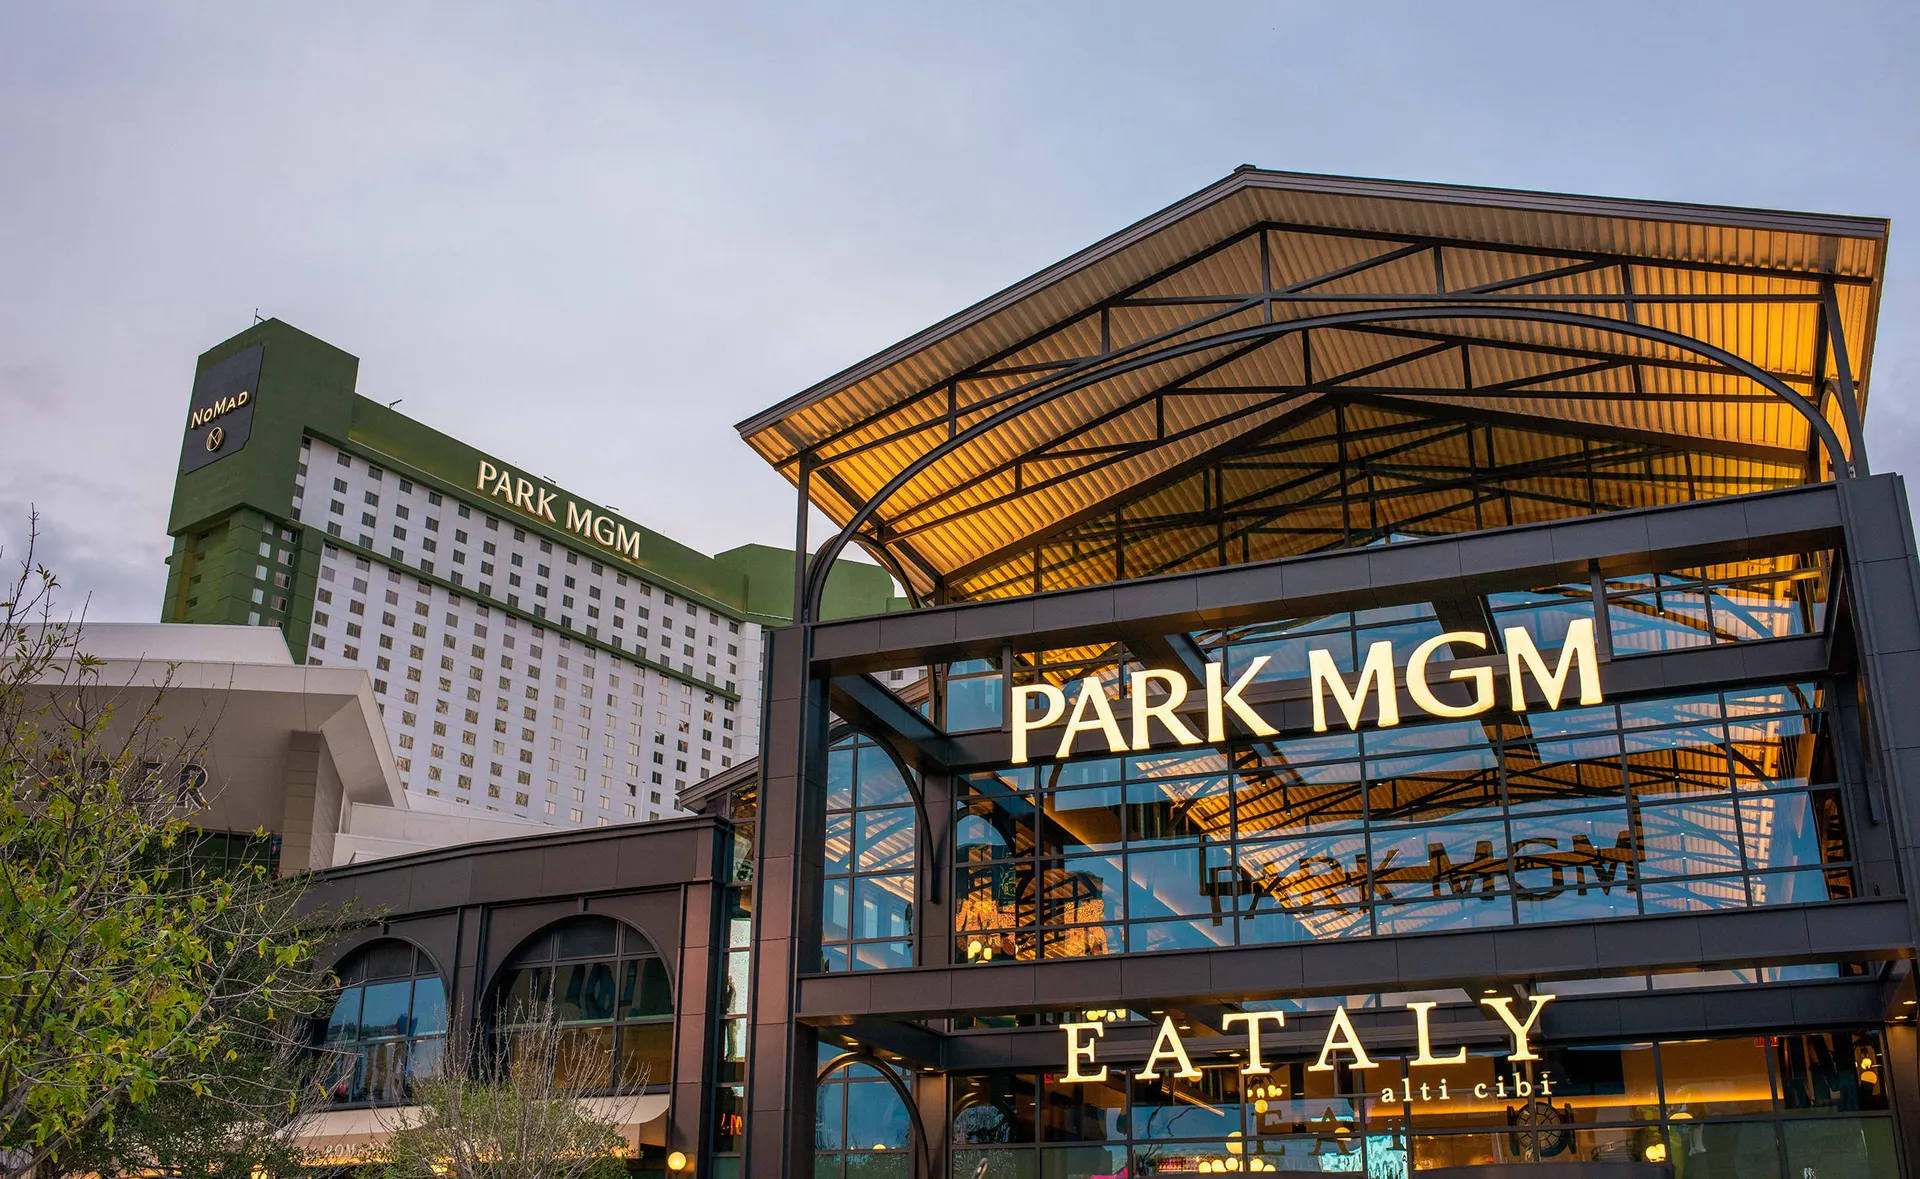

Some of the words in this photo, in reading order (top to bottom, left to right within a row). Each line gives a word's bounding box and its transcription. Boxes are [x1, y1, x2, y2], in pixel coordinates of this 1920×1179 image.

[476, 460, 558, 523] PARK
[565, 500, 641, 560] MGM
[1011, 655, 1280, 764] PARK
[1308, 617, 1604, 732] MGM
[1059, 994, 1557, 1084] EATALY
[1381, 1077, 1451, 1103] alti
[1474, 1072, 1553, 1099] cibi
